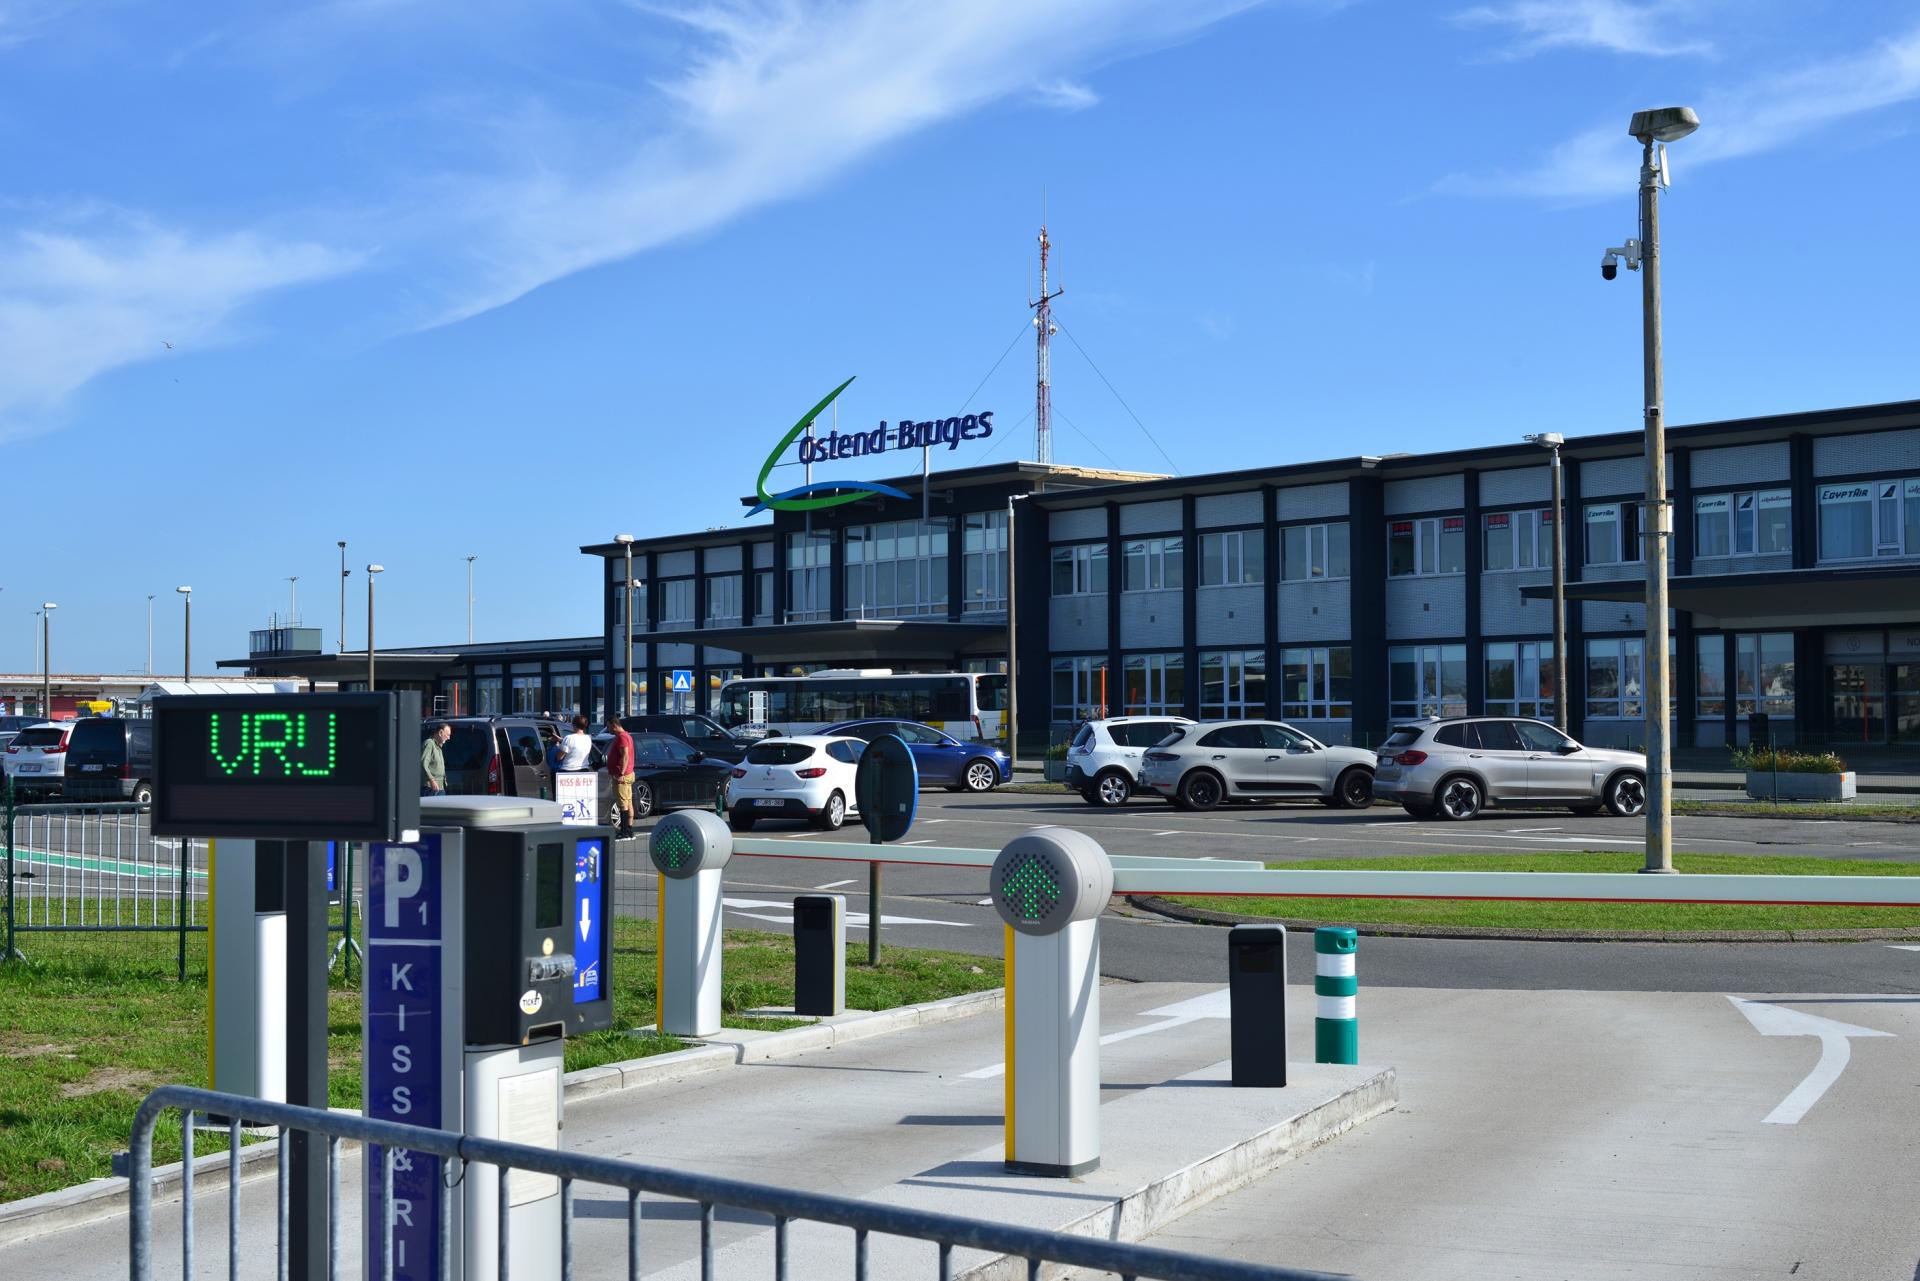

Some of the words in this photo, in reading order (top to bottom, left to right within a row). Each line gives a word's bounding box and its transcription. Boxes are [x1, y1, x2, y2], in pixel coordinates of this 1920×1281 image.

[799, 411, 994, 464] Ostend-Bruges
[560, 777, 574, 787] KISS
[575, 777, 582, 787] &
[583, 777, 593, 787] FLY
[523, 997, 540, 1007] TICKET
[391, 962, 414, 1115] KISS
